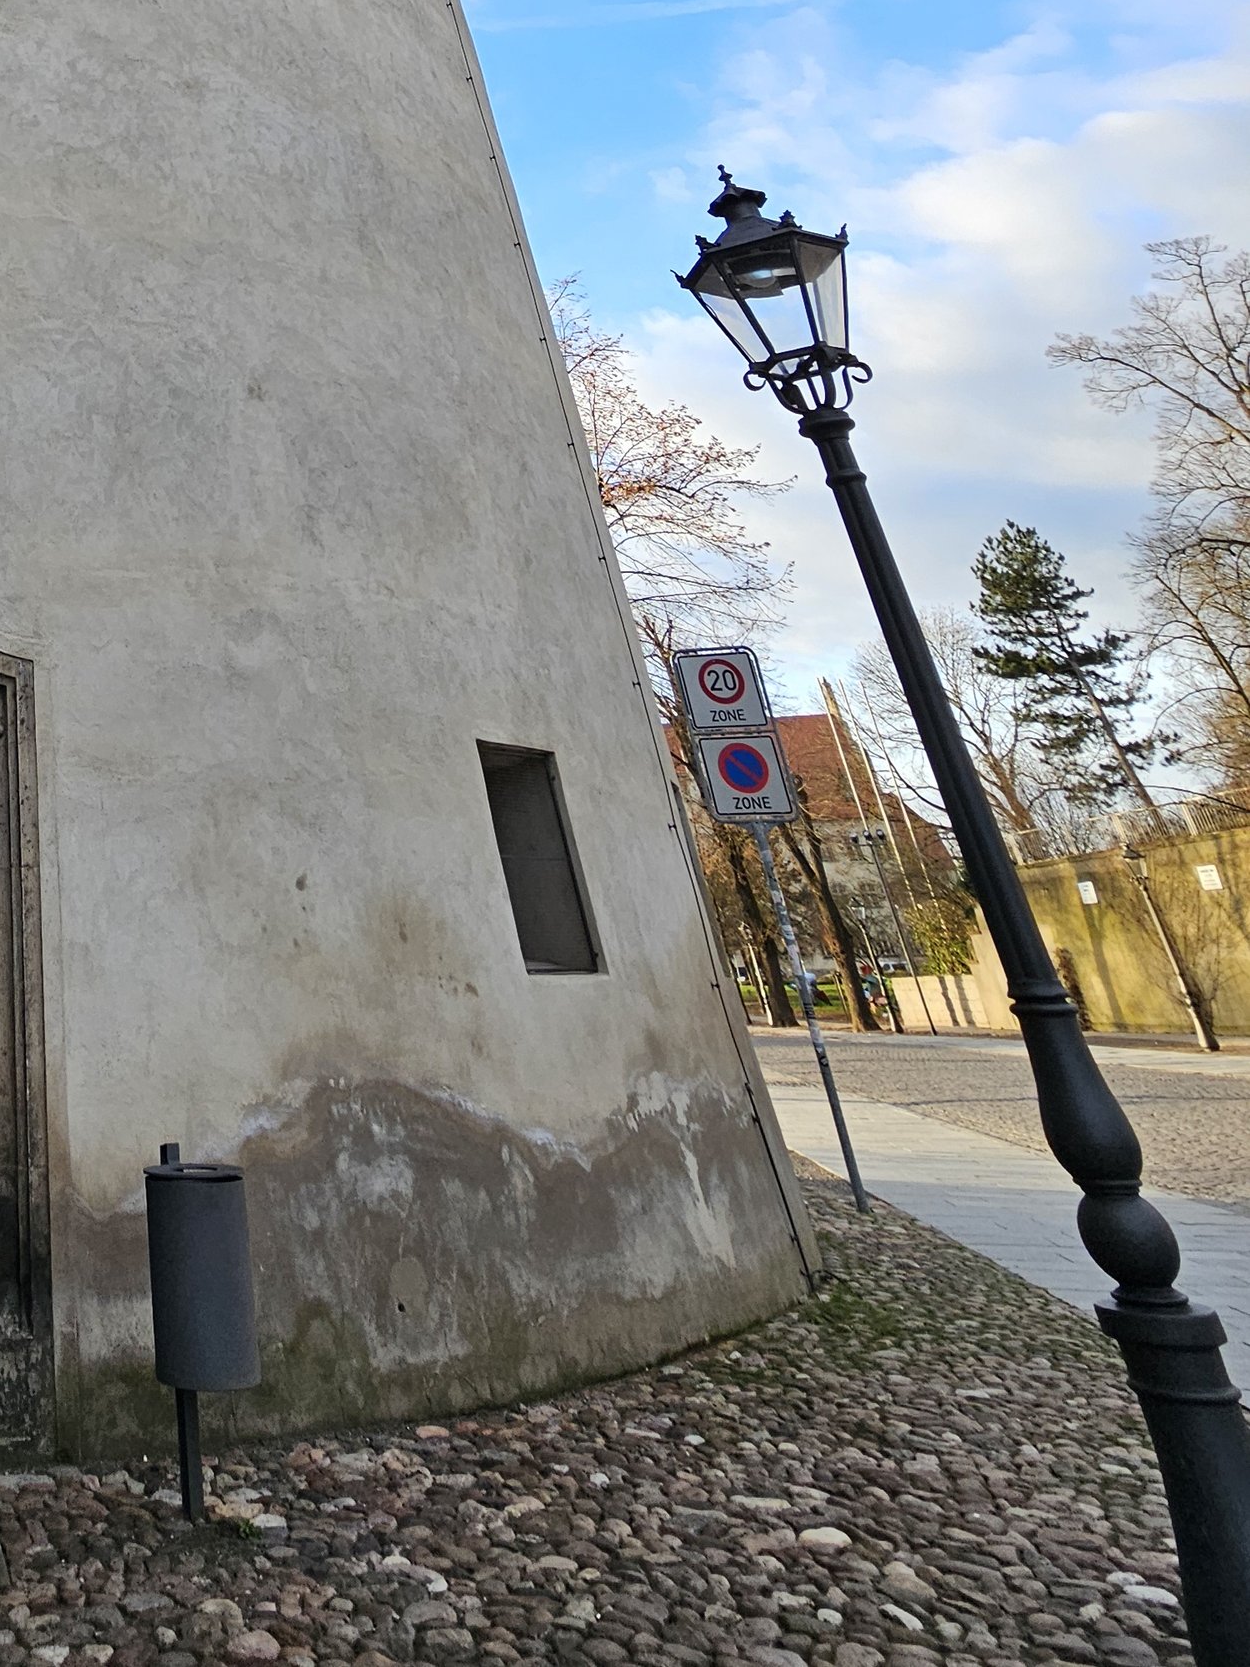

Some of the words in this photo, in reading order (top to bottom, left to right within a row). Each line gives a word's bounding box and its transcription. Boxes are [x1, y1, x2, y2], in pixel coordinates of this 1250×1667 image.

[707, 669, 737, 691] 20
[710, 709, 746, 722] ZONE
[732, 796, 772, 809] ZONE
